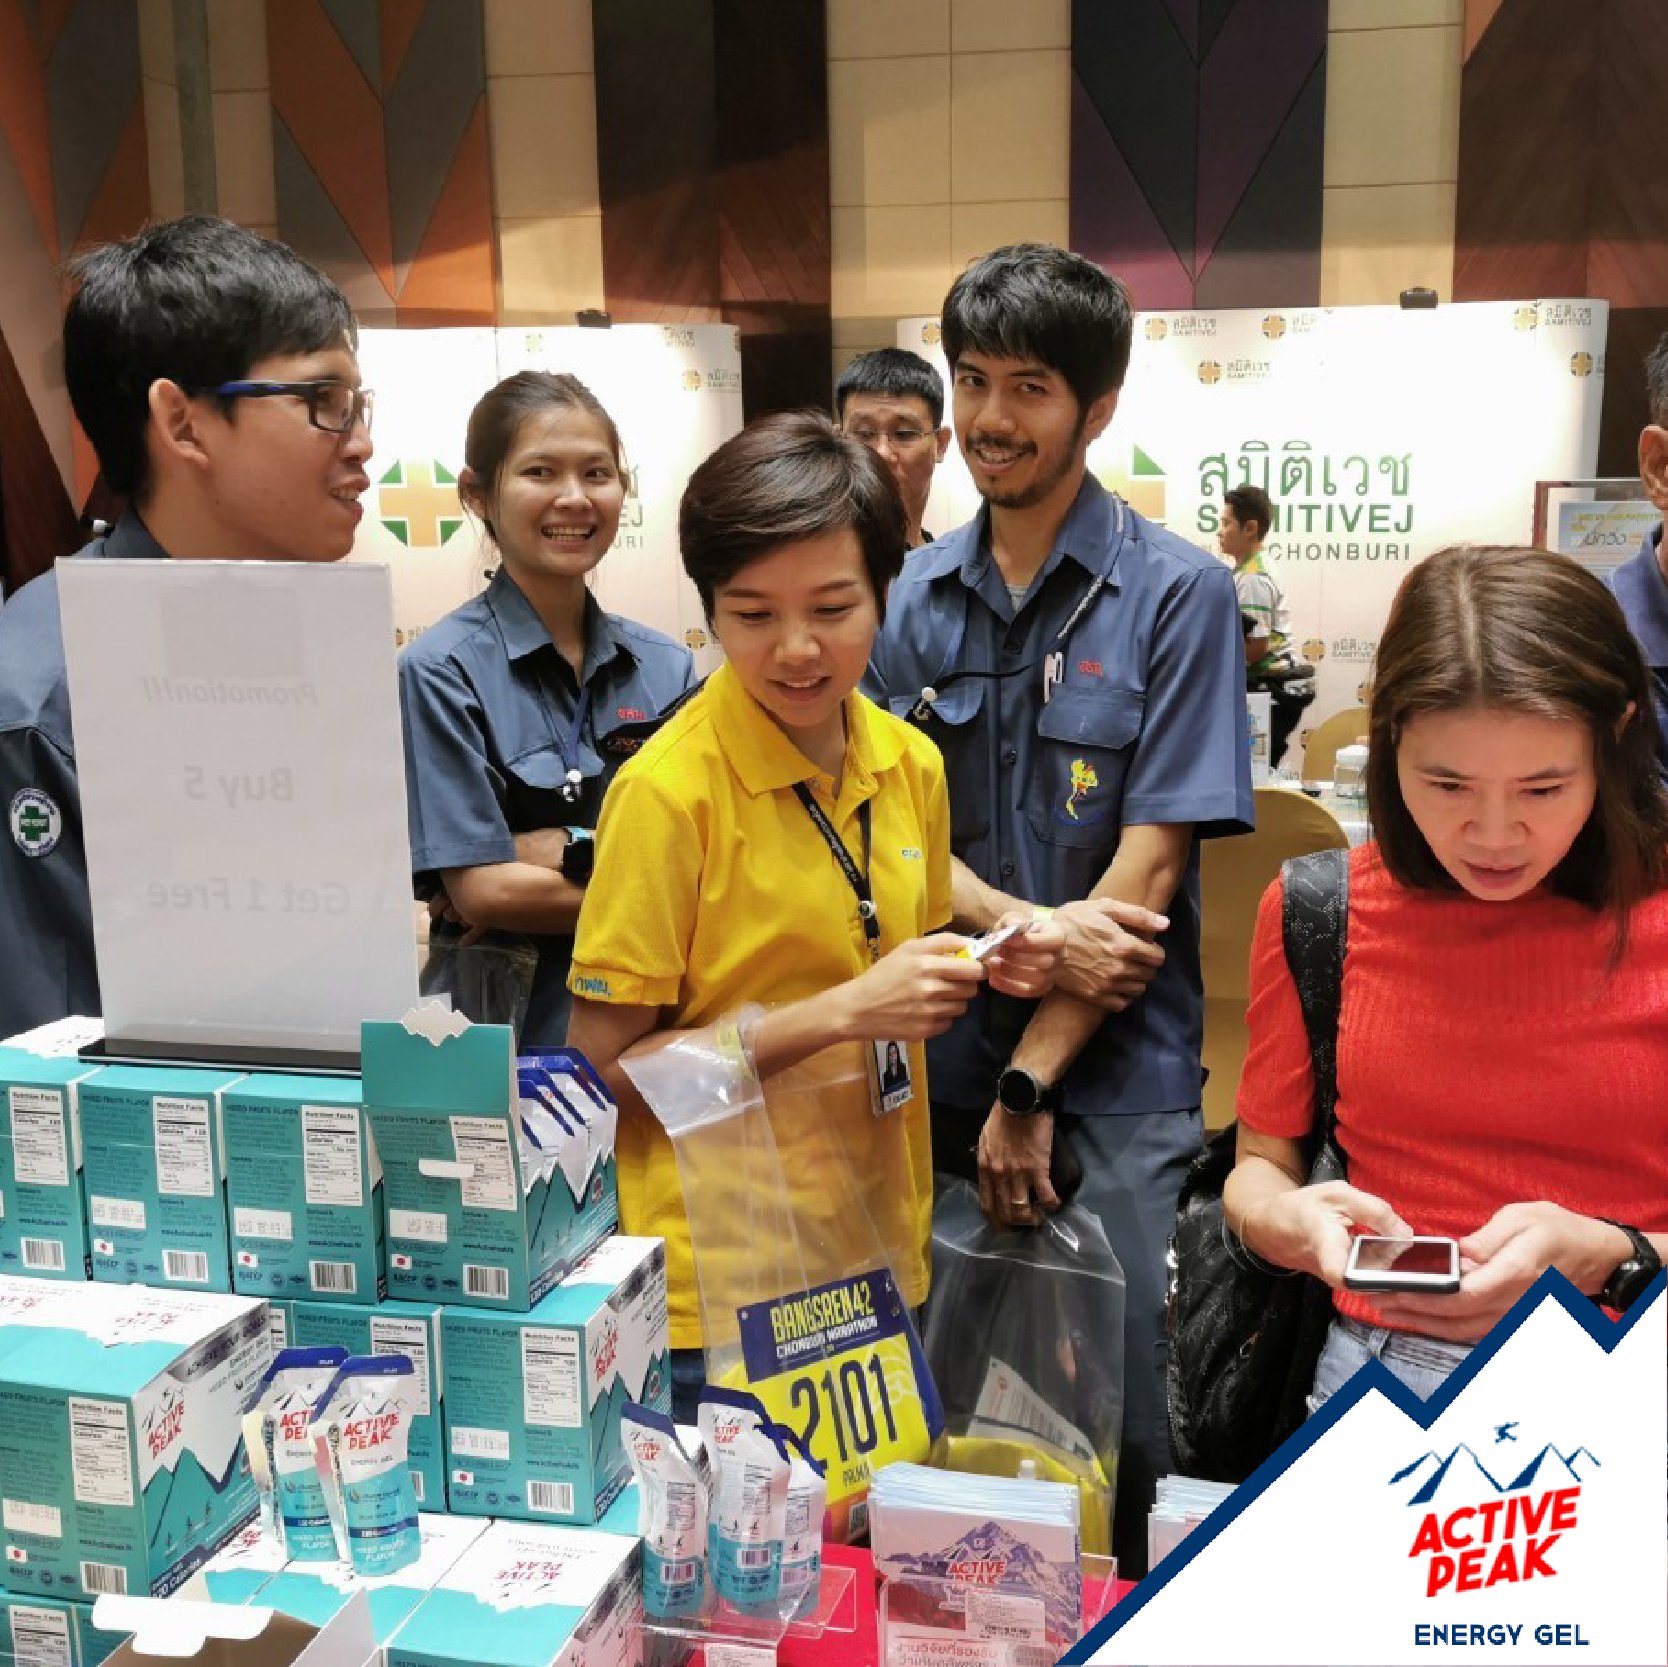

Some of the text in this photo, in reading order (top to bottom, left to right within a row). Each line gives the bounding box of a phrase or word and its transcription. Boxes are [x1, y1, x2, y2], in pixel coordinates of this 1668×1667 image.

[1198, 440, 1413, 497] สมิติเวช
[1268, 542, 1410, 561] CHONBURI
[853, 1280, 875, 1317] 42
[826, 1315, 878, 1342] MARATHON
[790, 1353, 898, 1471] 2101
[344, 1413, 400, 1437] ACTIVE
[348, 1431, 393, 1450] PEAK
[949, 1560, 1006, 1574] ACTIVE
